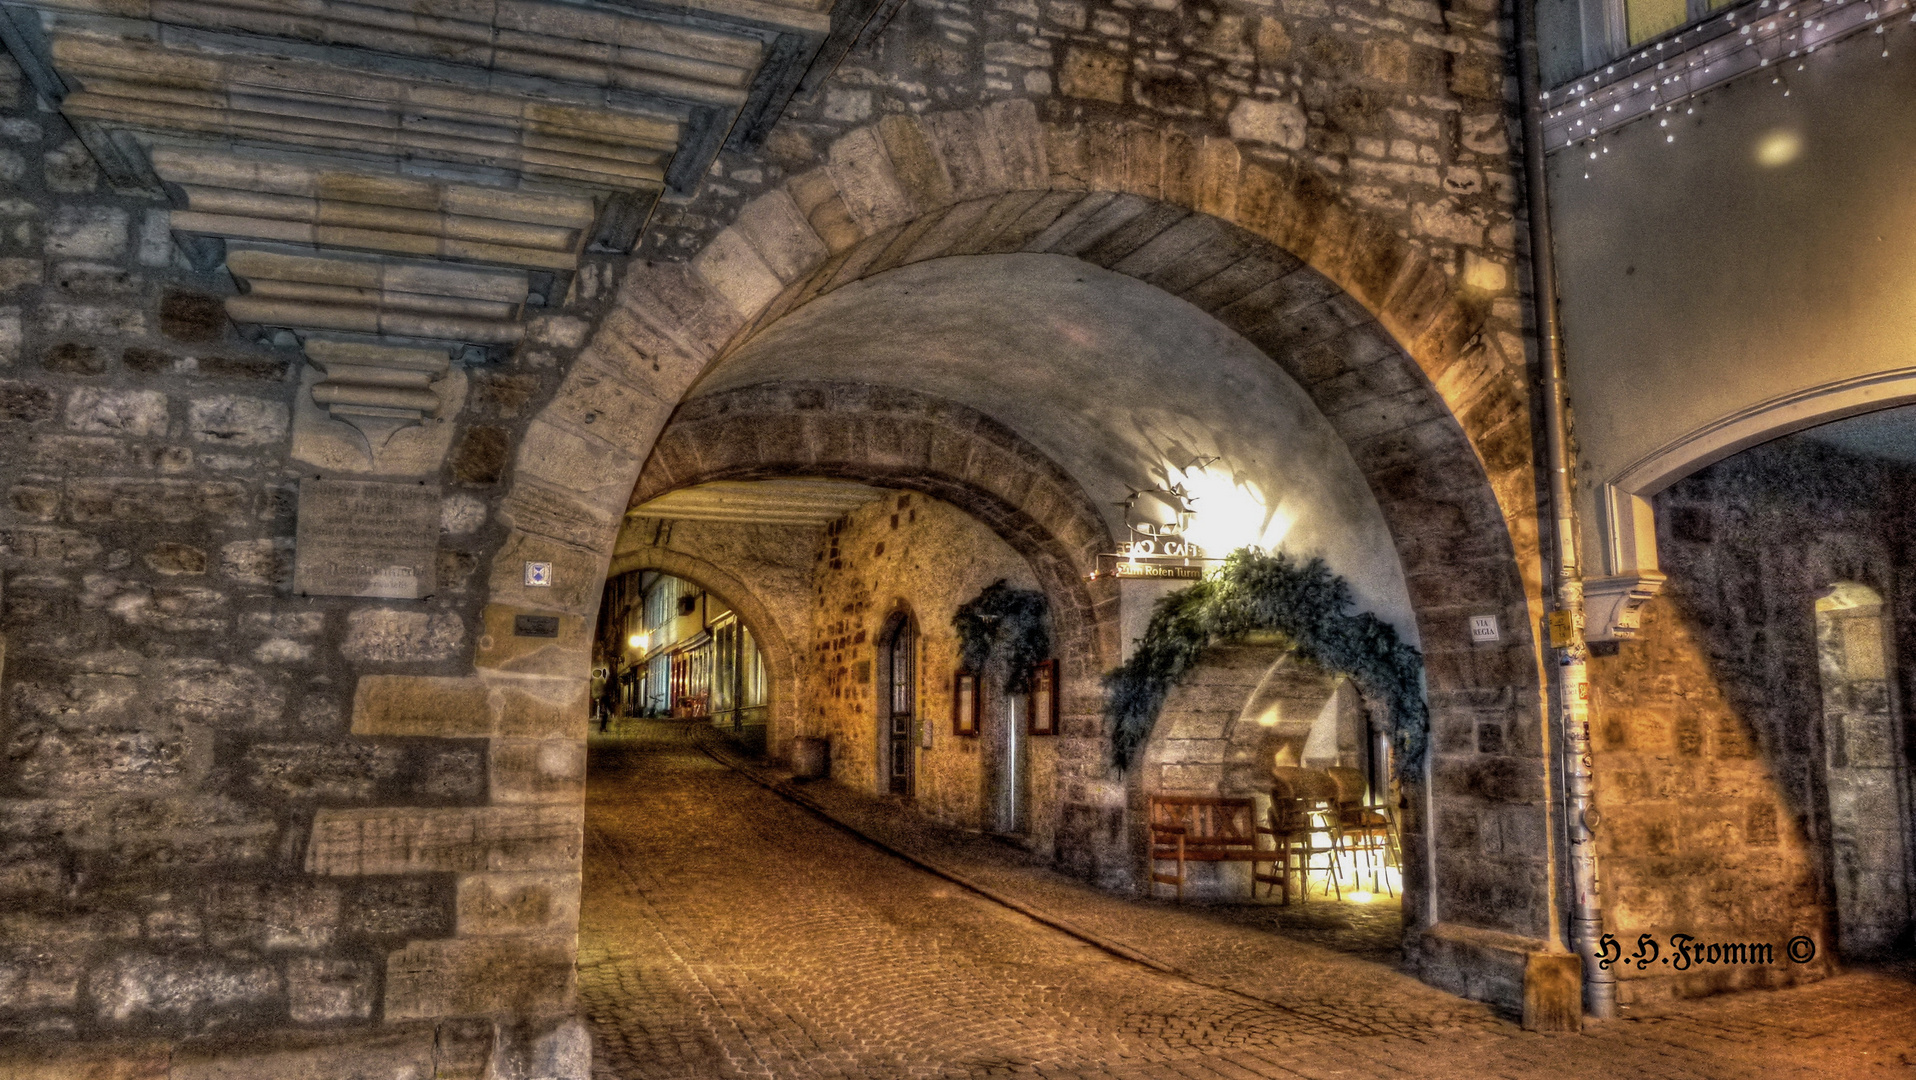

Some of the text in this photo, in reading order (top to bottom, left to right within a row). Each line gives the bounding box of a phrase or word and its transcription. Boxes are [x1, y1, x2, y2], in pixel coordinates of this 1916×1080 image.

[1120, 565, 1200, 577] Zum Roten Turm
[1473, 628, 1494, 636] REGIA
